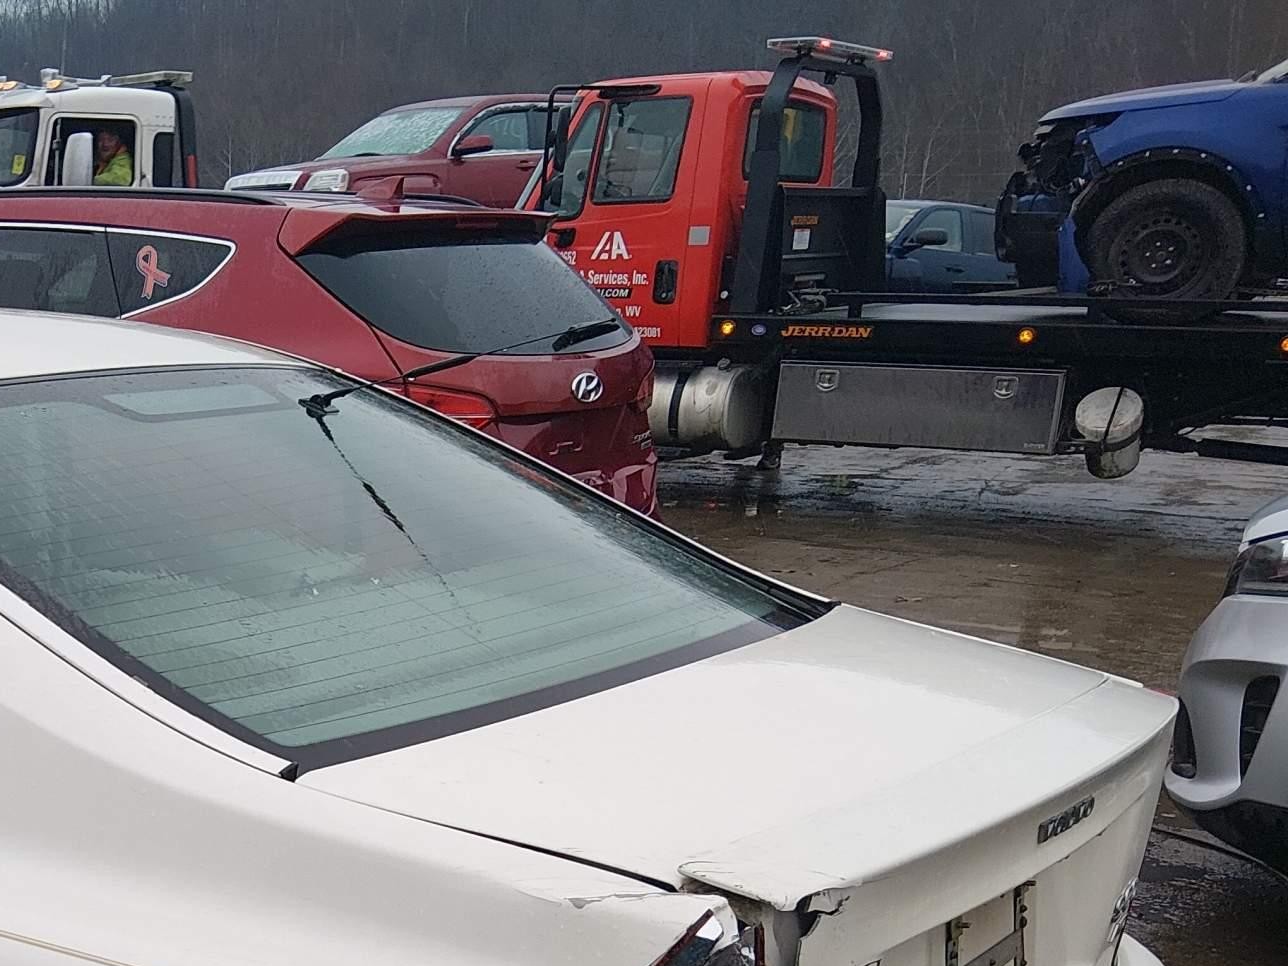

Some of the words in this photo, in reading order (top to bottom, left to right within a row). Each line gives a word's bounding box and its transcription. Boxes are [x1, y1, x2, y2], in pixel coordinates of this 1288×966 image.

[587, 269, 631, 286] Services,
[632, 269, 649, 285] Inc.
[625, 305, 642, 318] WV
